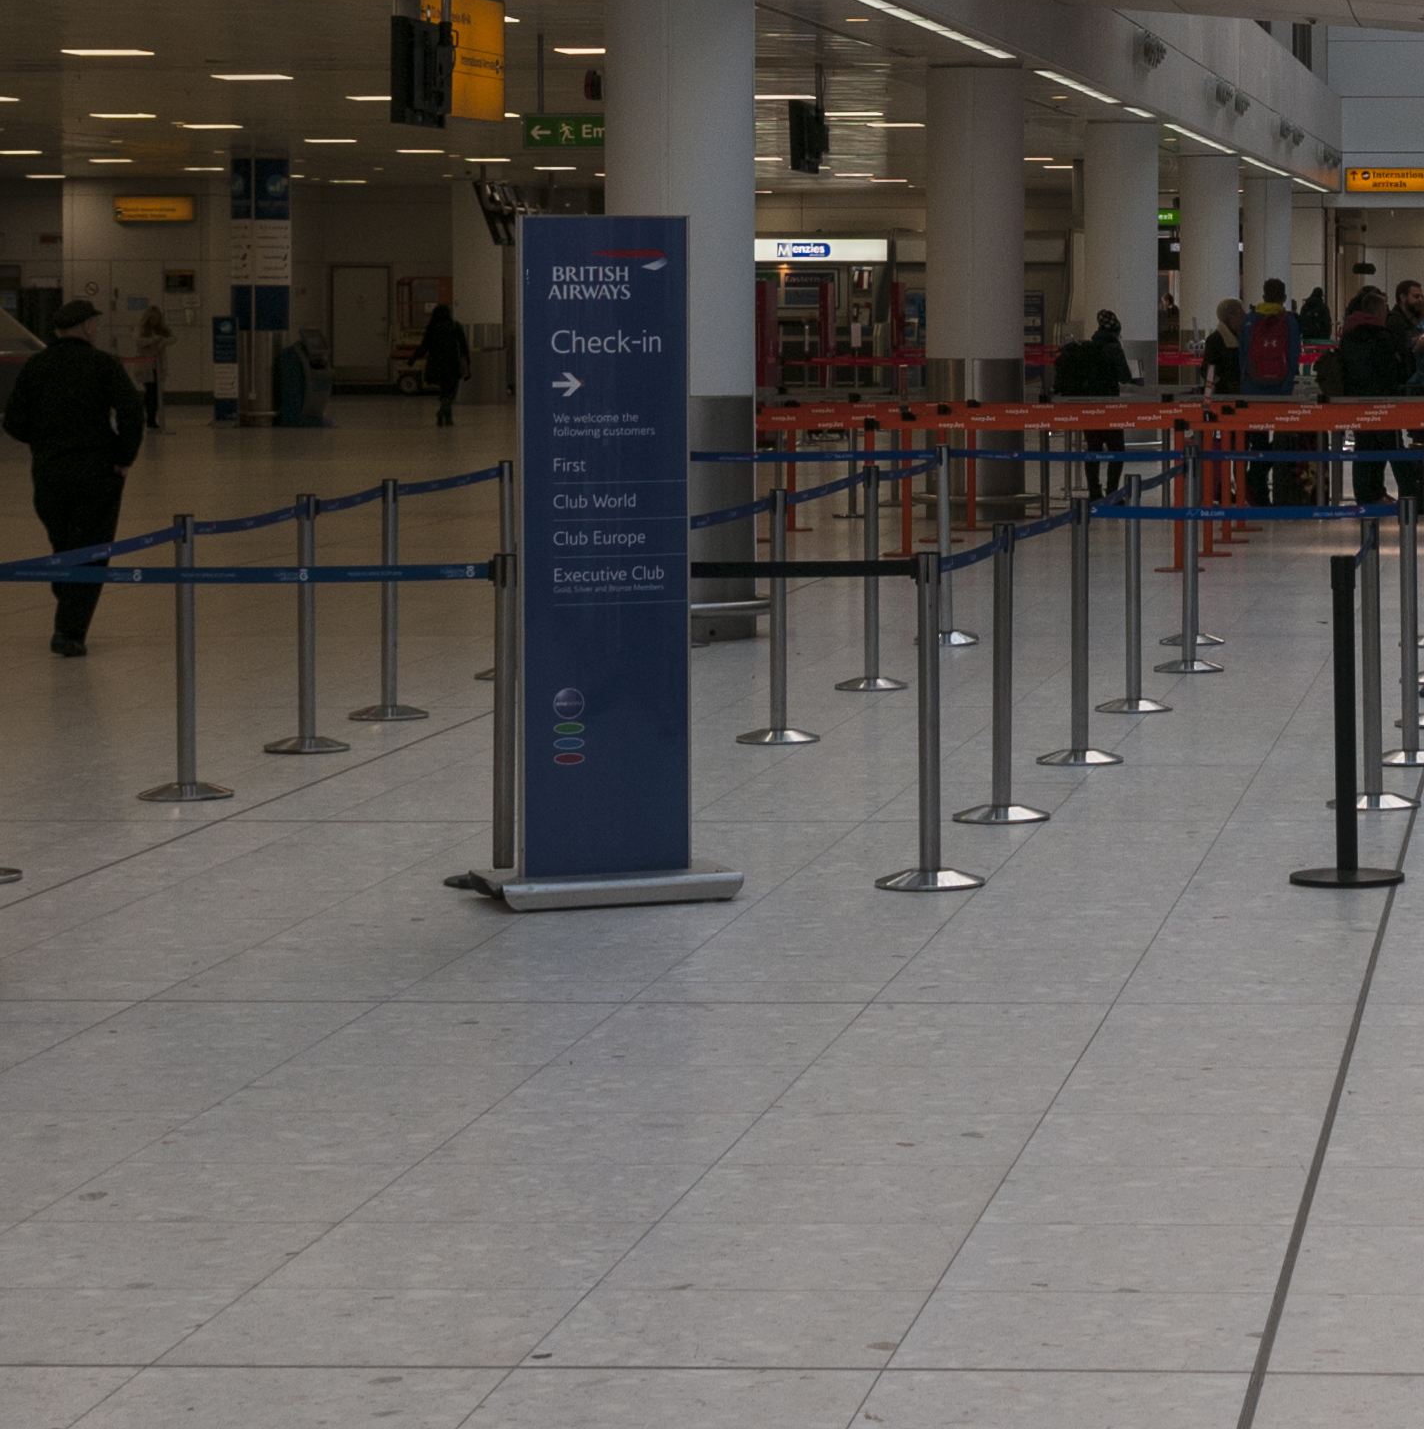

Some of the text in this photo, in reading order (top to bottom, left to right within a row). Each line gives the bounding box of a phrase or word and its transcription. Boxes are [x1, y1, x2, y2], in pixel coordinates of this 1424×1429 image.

[1372, 180, 1406, 188] arrivals
[777, 243, 826, 257] Menzies
[552, 266, 629, 282] BRITISH
[548, 284, 631, 300] AIRWAYS
[551, 329, 662, 354] Check-in
[553, 412, 639, 423] We welcome the
[553, 426, 656, 438] following customers
[1110, 421, 1135, 429] easyJet
[1335, 422, 1361, 430] easyJet
[553, 457, 587, 473] First
[553, 493, 637, 510] Club World
[1200, 509, 1226, 518] ba.com
[553, 530, 646, 548] Club Europe
[553, 565, 665, 583] Executive Club
[573, 584, 593, 593] Silver
[594, 585, 607, 593] and
[633, 583, 665, 591] Members
